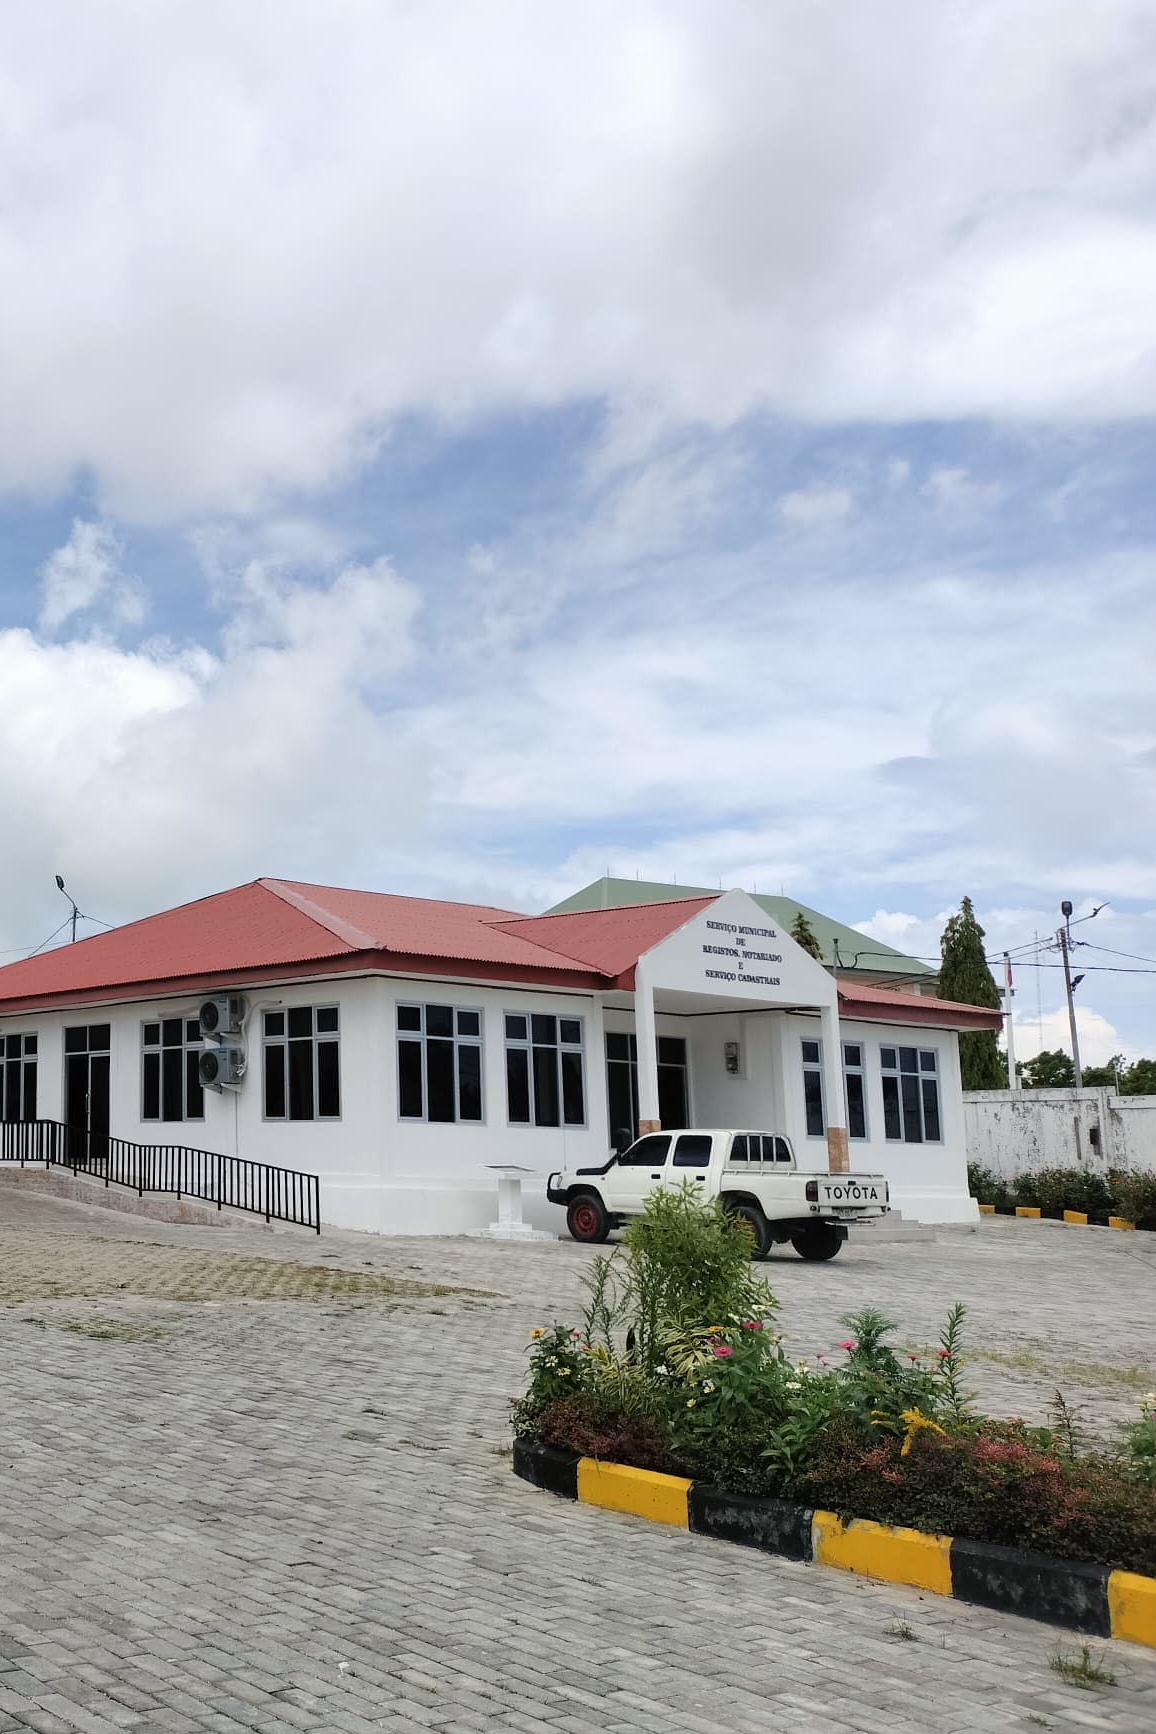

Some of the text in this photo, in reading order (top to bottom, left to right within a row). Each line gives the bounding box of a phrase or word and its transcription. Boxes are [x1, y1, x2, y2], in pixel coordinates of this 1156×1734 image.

[707, 921, 776, 937] SERVIÇO MUNICIPAL
[736, 937, 746, 946] DE
[742, 951, 782, 962] NOTARIADO
[738, 962, 743, 970] E
[705, 970, 780, 985] SERVIÇO CADASTRAIS
[824, 1187, 878, 1199] TOYOTA
